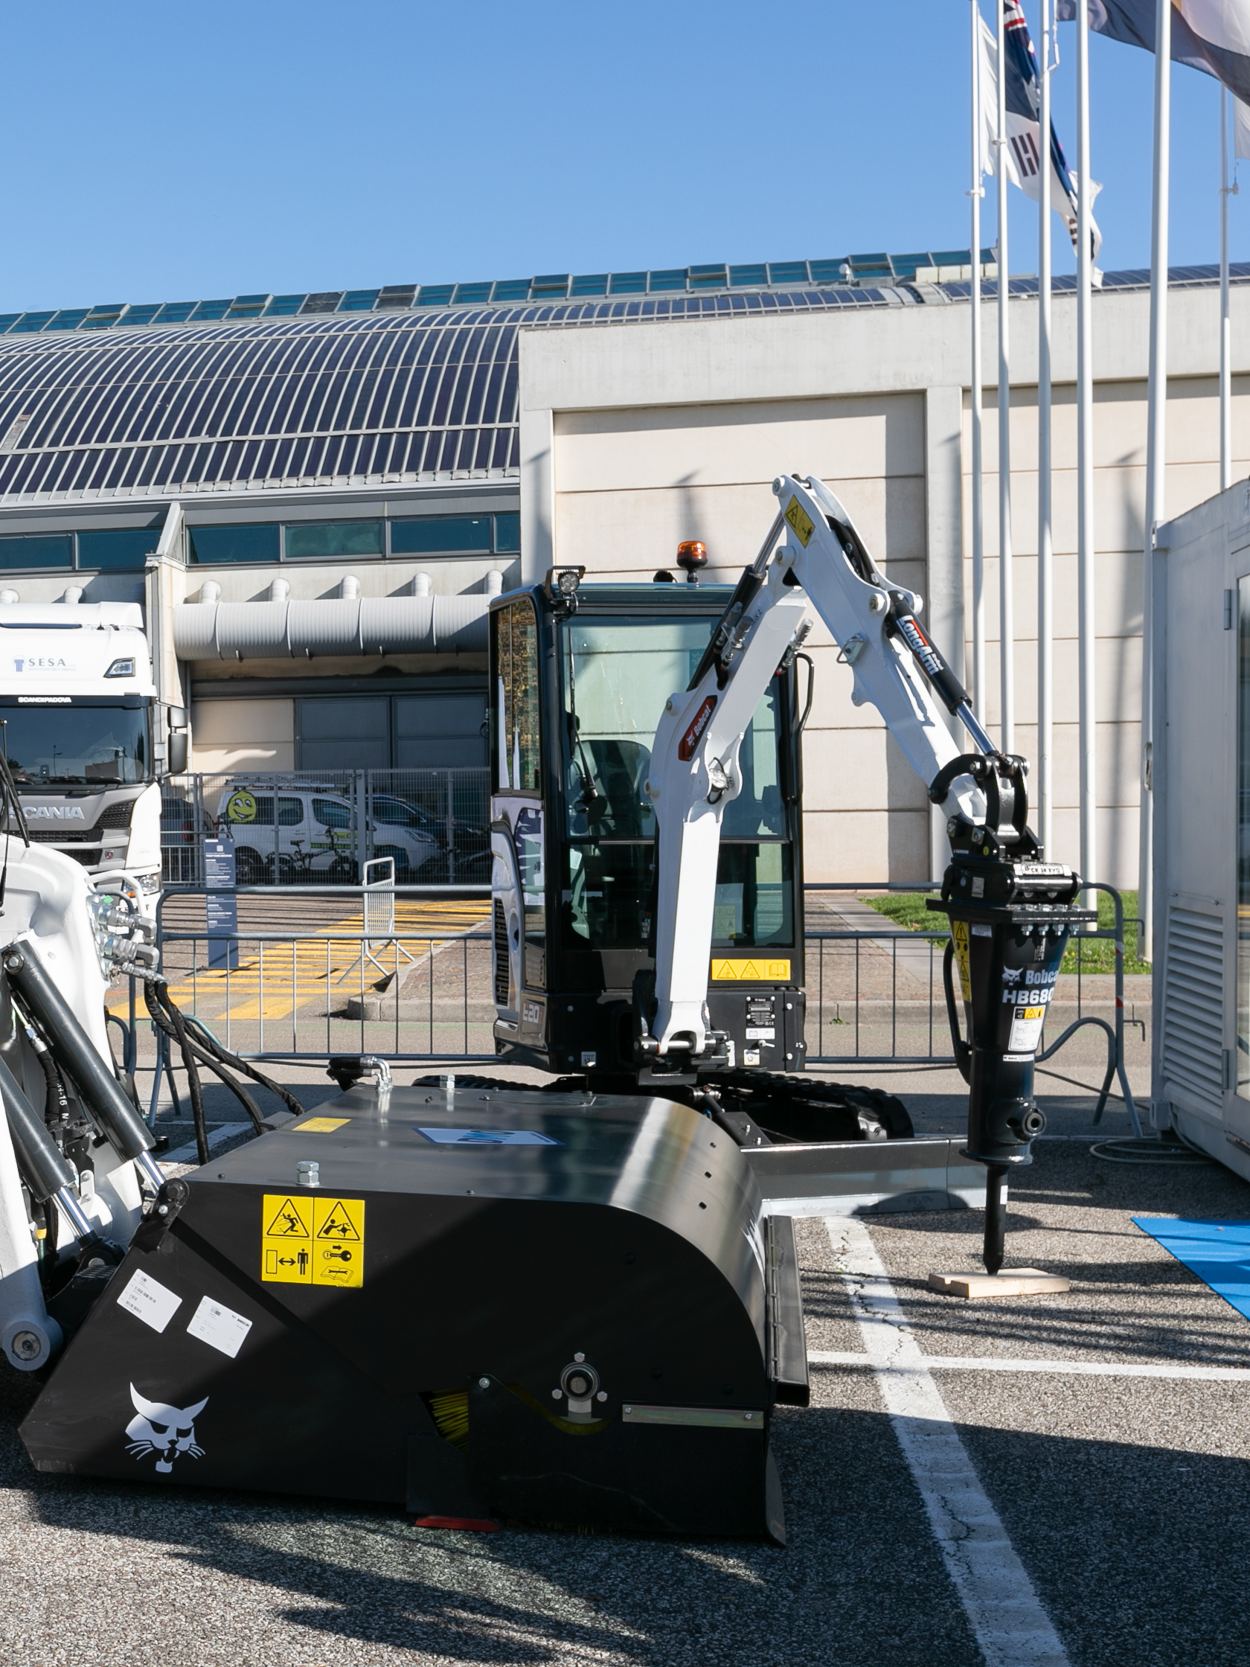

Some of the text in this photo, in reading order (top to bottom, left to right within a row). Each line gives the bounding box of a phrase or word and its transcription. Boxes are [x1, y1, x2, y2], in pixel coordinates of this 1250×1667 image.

[899, 614, 939, 675] LongArm
[28, 657, 66, 667] SESA
[693, 704, 711, 736] Bobcat
[1025, 969, 1059, 985] Bobca
